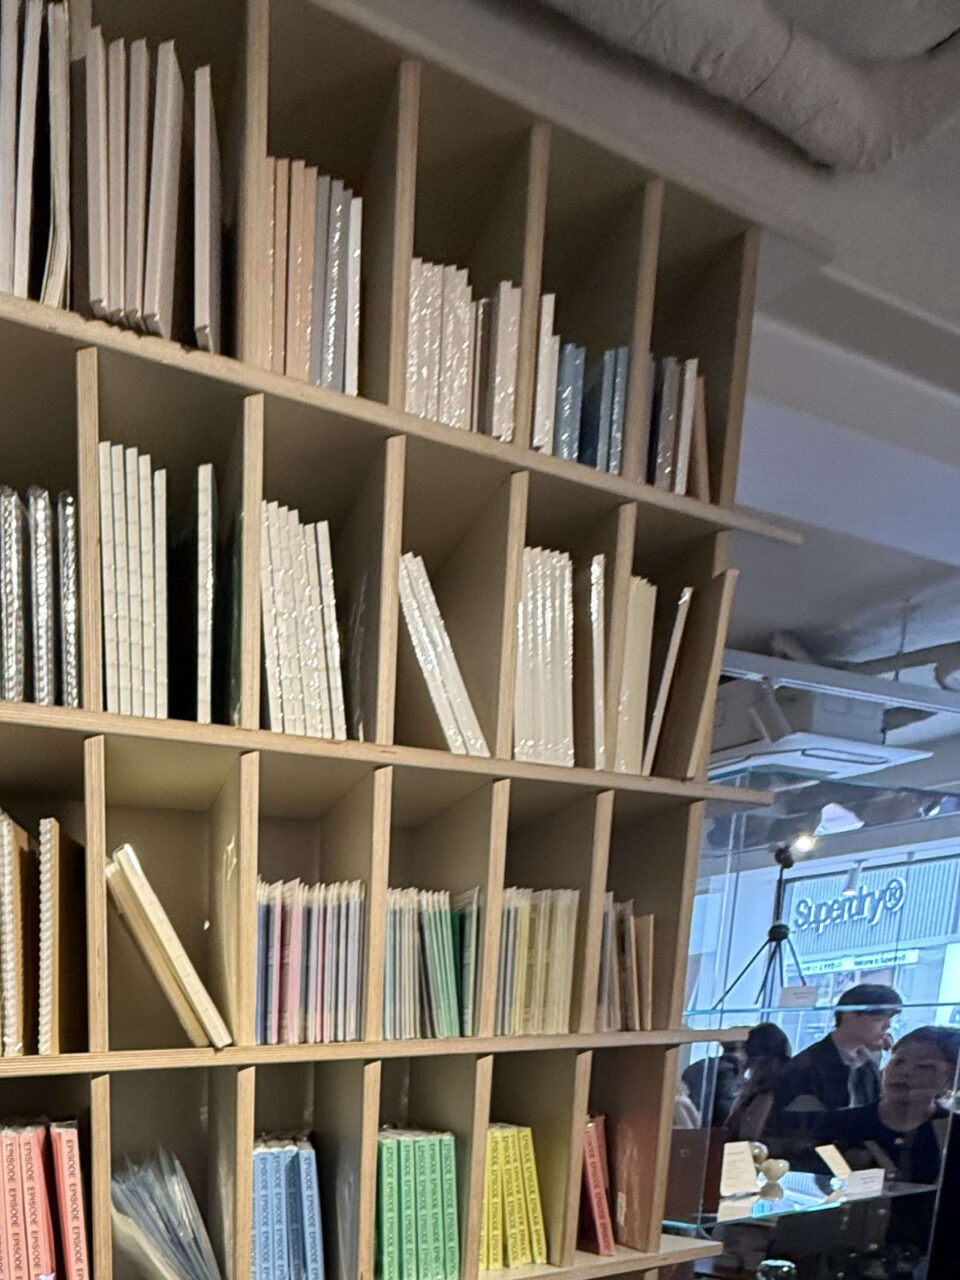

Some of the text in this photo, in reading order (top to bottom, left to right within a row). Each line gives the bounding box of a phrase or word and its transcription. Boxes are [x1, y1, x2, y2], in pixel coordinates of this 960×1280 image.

[6, 1142, 16, 1183] EPISODE
[24, 1142, 34, 1182] EPISODE
[66, 1140, 76, 1178] EPISODE
[9, 1188, 19, 1228] EPISODE
[28, 1187, 37, 1225] EPISODE
[69, 1183, 79, 1221] EPISODE
[12, 1232, 22, 1271] EPISODE
[31, 1231, 41, 1268] EPISODE
[72, 1226, 83, 1264] EPISODE
